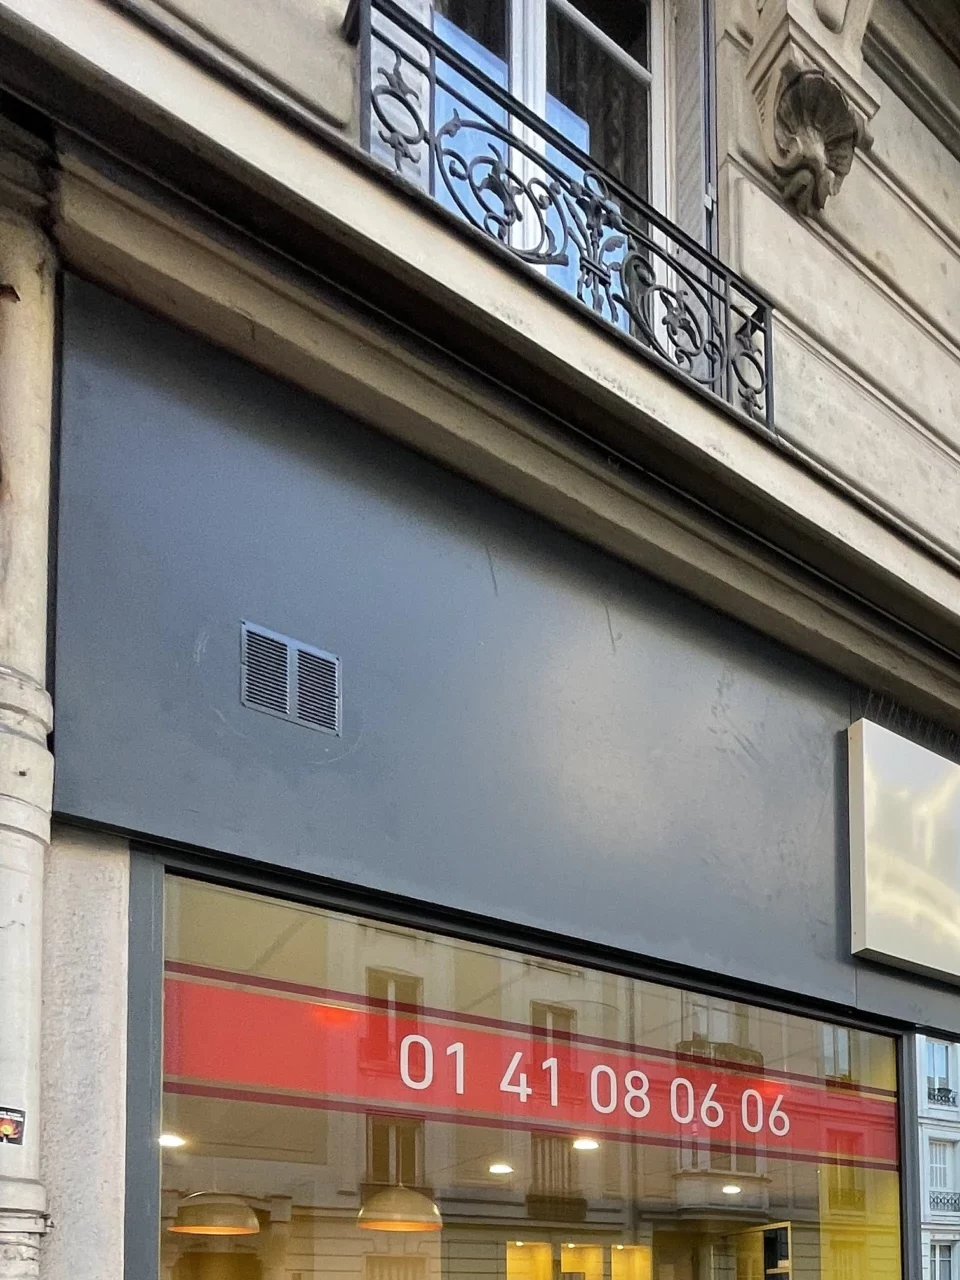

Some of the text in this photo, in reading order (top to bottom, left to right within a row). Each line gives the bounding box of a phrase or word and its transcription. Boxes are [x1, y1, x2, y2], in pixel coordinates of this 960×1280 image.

[400, 1034, 791, 1137] 01 41 08 06 06
